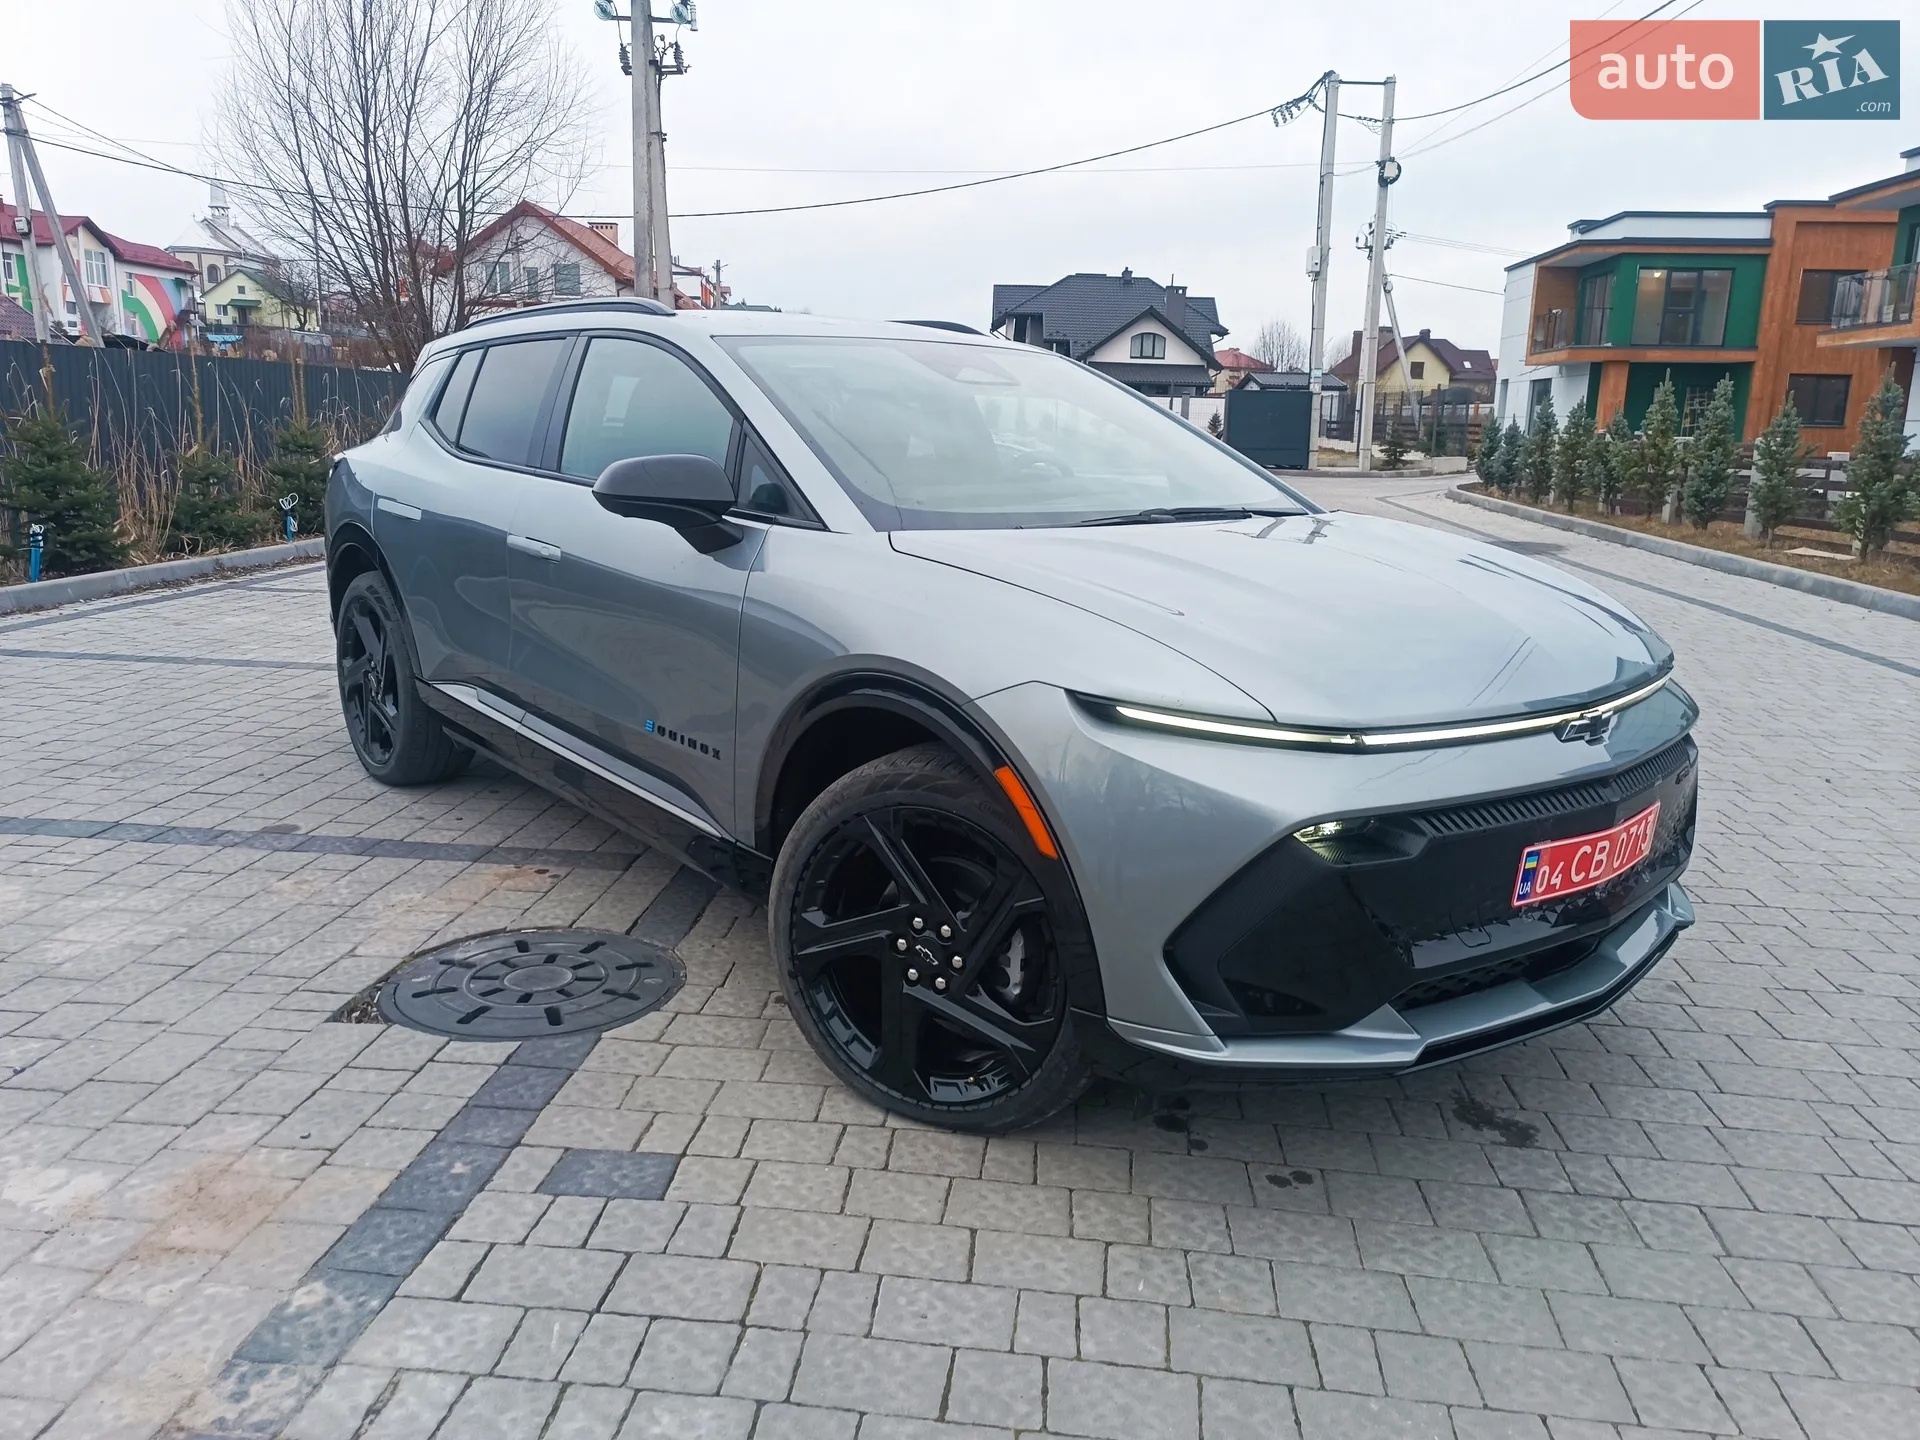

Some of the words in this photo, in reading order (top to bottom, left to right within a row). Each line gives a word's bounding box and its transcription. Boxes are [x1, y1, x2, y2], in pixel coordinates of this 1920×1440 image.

[1535, 861, 1565, 894] 04
[1570, 840, 1610, 883] CB
[1519, 881, 1531, 895] UA
